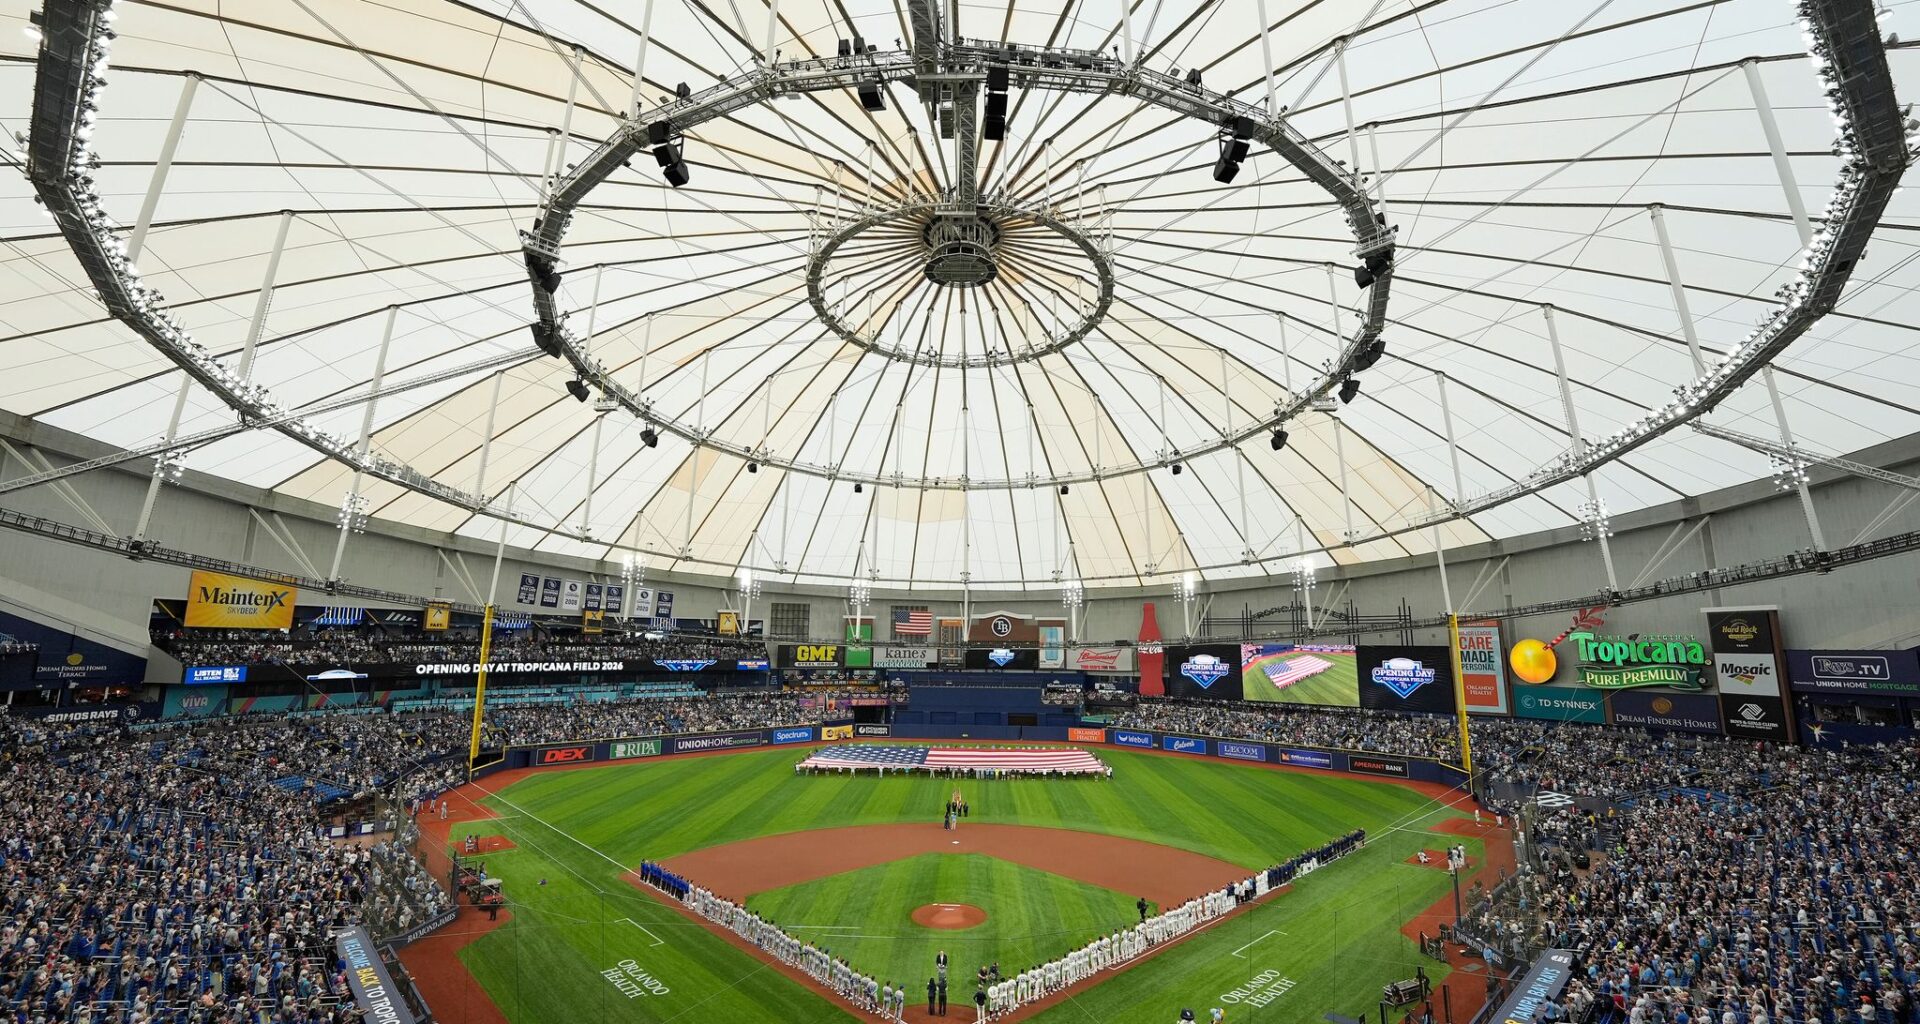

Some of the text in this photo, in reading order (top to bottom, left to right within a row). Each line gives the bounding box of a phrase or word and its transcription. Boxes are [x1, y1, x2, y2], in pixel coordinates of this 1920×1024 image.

[198, 586, 289, 614] MaintenX
[1722, 625, 1757, 634] Hard Rock
[1459, 637, 1494, 650] CARE
[1569, 632, 1705, 667] Tropicana
[796, 645, 838, 661] GMF
[1460, 650, 1495, 663] MADE
[194, 669, 222, 677] LISTEN
[415, 661, 624, 675] OPENING DAY AT TROPICANA FIELD 2026
[1374, 669, 1433, 678] OPENING DAY
[1461, 663, 1496, 671] PERSONAL
[1720, 663, 1771, 675] Mosaic
[1586, 669, 1688, 685] PURE PREMIUM
[1843, 681, 1868, 689] HOME
[1869, 683, 1918, 691] MORTGAGE
[182, 696, 208, 707] VIVA
[1538, 698, 1596, 710] TD SYNNEX
[47, 710, 118, 722] SOMOS RAYS
[1615, 714, 1717, 729] DREAM FINDERS HOMES
[776, 732, 807, 741] Spectrum
[1128, 735, 1149, 744] Webull
[544, 748, 587, 762] DEX
[625, 741, 656, 756] RIPA
[1224, 745, 1258, 755] LECOM
[1354, 761, 1403, 773] AMERANT BANK
[407, 921, 439, 943] RAYMOND
[342, 938, 371, 969] WELCOME
[355, 967, 381, 988] BACK
[600, 967, 646, 999] HEALTH
[618, 959, 670, 995] ORLANDO
[365, 985, 386, 999] TO
[1220, 969, 1280, 1004] ORLANDO
[1243, 978, 1297, 1008] HEALTH
